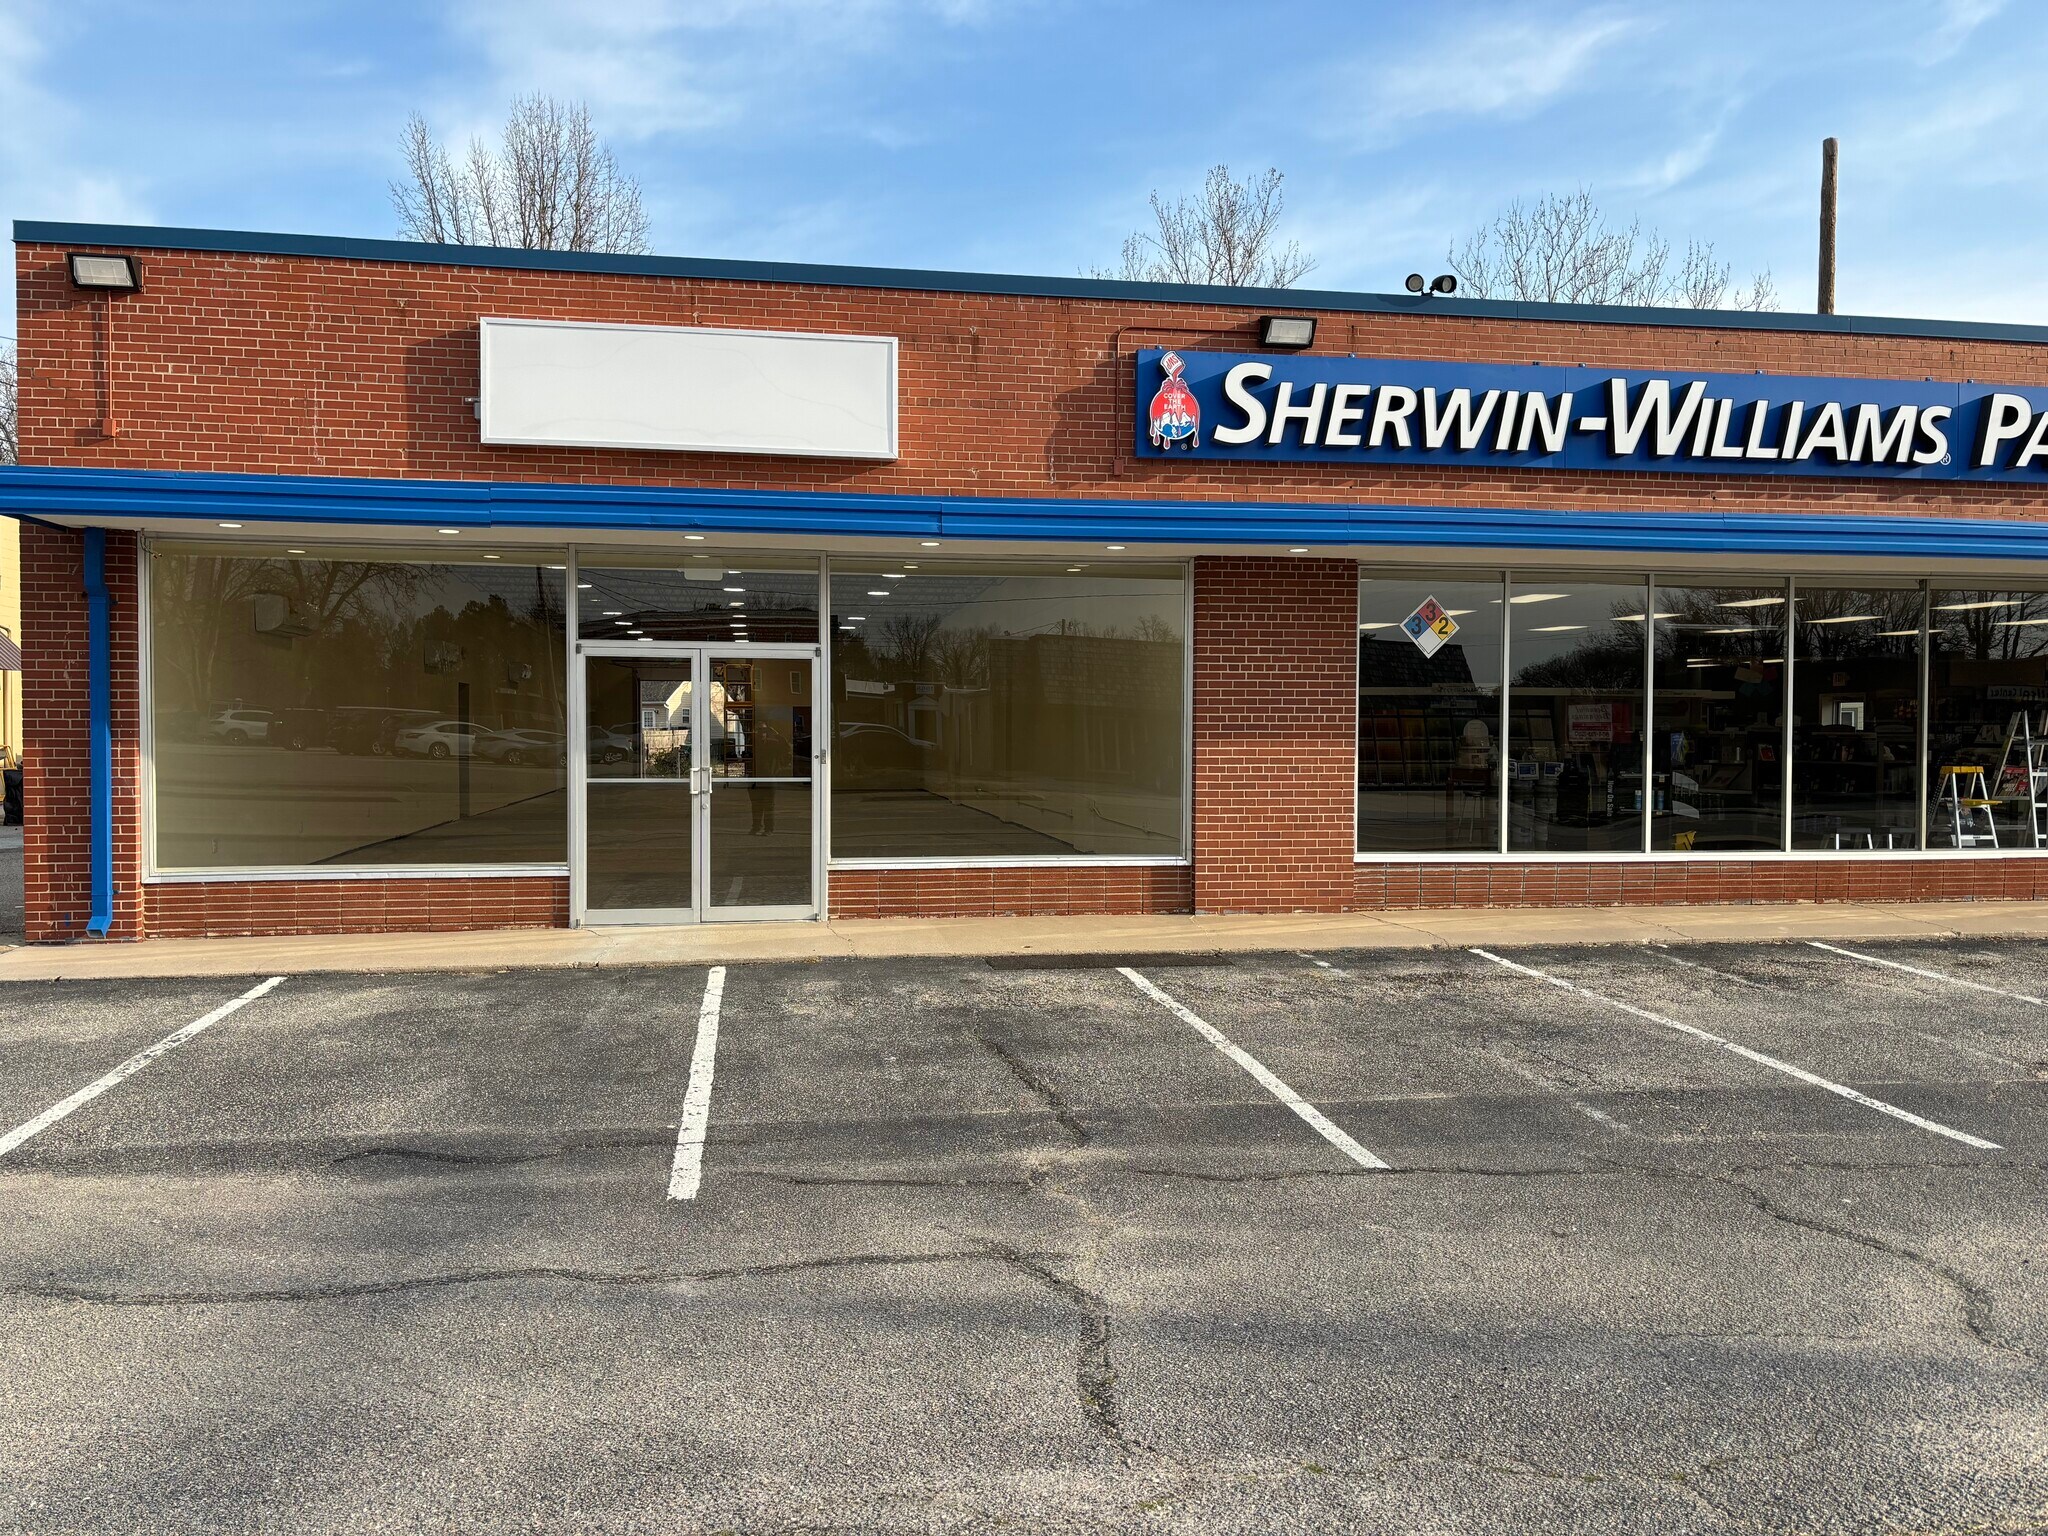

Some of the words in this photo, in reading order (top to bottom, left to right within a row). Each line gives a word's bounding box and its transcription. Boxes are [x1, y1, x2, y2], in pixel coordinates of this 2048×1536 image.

[1214, 363, 1952, 465] SHERWIN-WILLIAMS
[1425, 603, 1437, 621] 3
[1411, 616, 1422, 635] 3
[1438, 616, 1449, 635] 2
[1606, 794, 1615, 803] On
[1606, 803, 1614, 817] Sale
